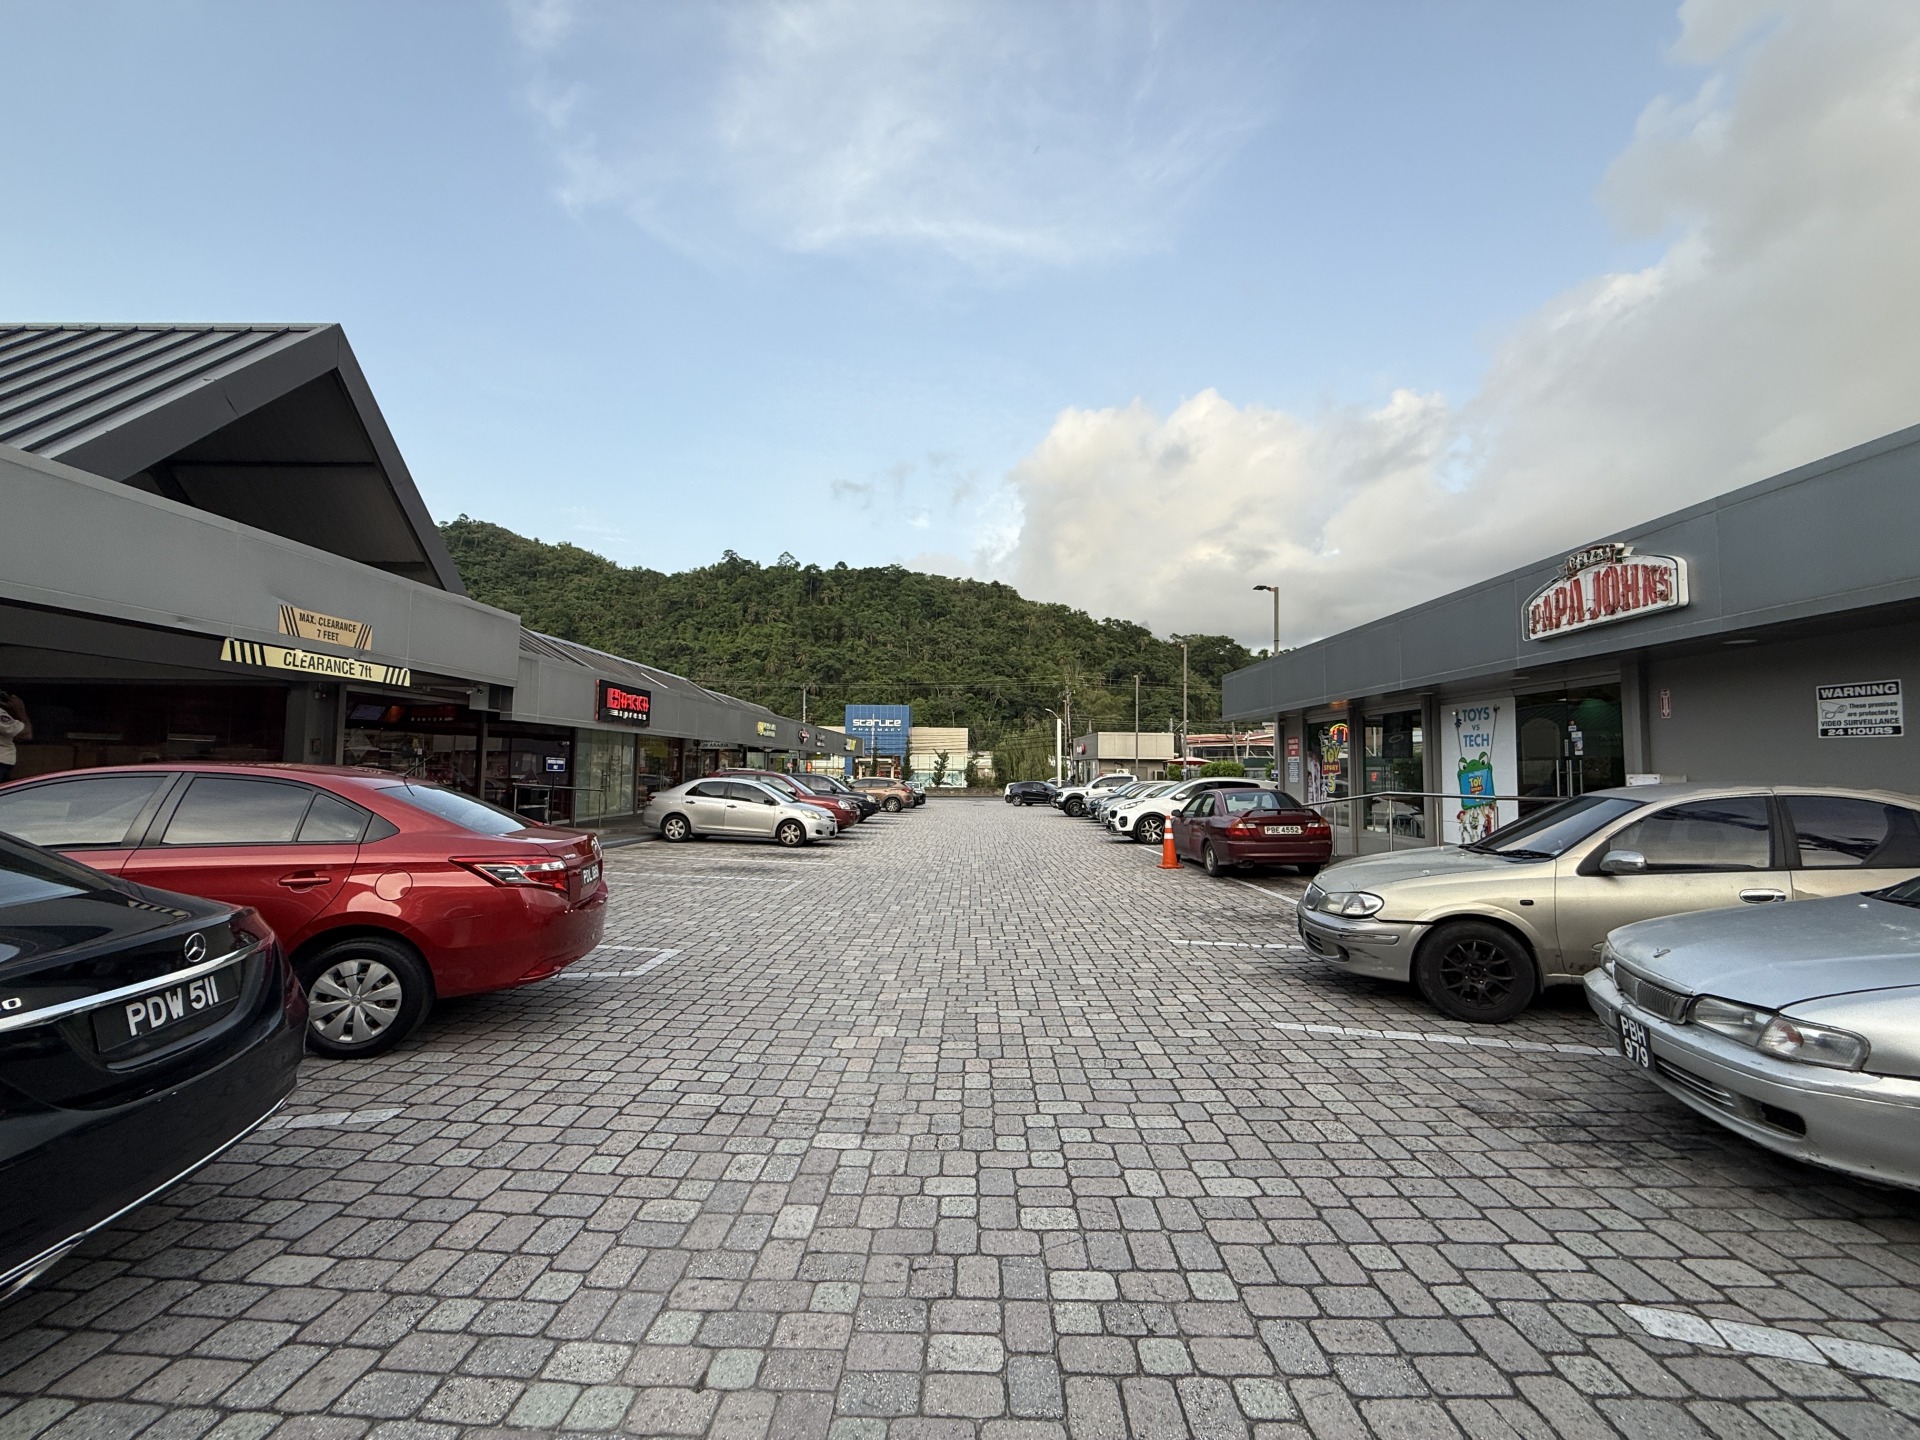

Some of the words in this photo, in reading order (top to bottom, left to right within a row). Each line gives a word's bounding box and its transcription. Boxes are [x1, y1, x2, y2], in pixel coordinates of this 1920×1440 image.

[1531, 577, 1585, 634] PAPA
[299, 612, 316, 625] MAX.
[318, 617, 357, 634] CLEARANCE
[316, 629, 322, 639] 7
[323, 631, 340, 642] FEET
[283, 651, 355, 676] CLEARANCE
[358, 664, 372, 679] 7ft
[1821, 683, 1897, 699] WARNING
[1868, 701, 1898, 709] premises
[1462, 706, 1490, 721] TOYS
[1859, 710, 1889, 718] protected
[1844, 717, 1900, 727] SURVEILLANCE
[1848, 727, 1894, 736] HOURS
[1463, 733, 1490, 748] TECH
[1323, 745, 1339, 763] TOY
[1468, 776, 1482, 787] TOY
[125, 987, 184, 1036] PDW
[189, 975, 219, 1010] 511
[1620, 1015, 1647, 1047] PBH
[1624, 1037, 1649, 1068] 979
